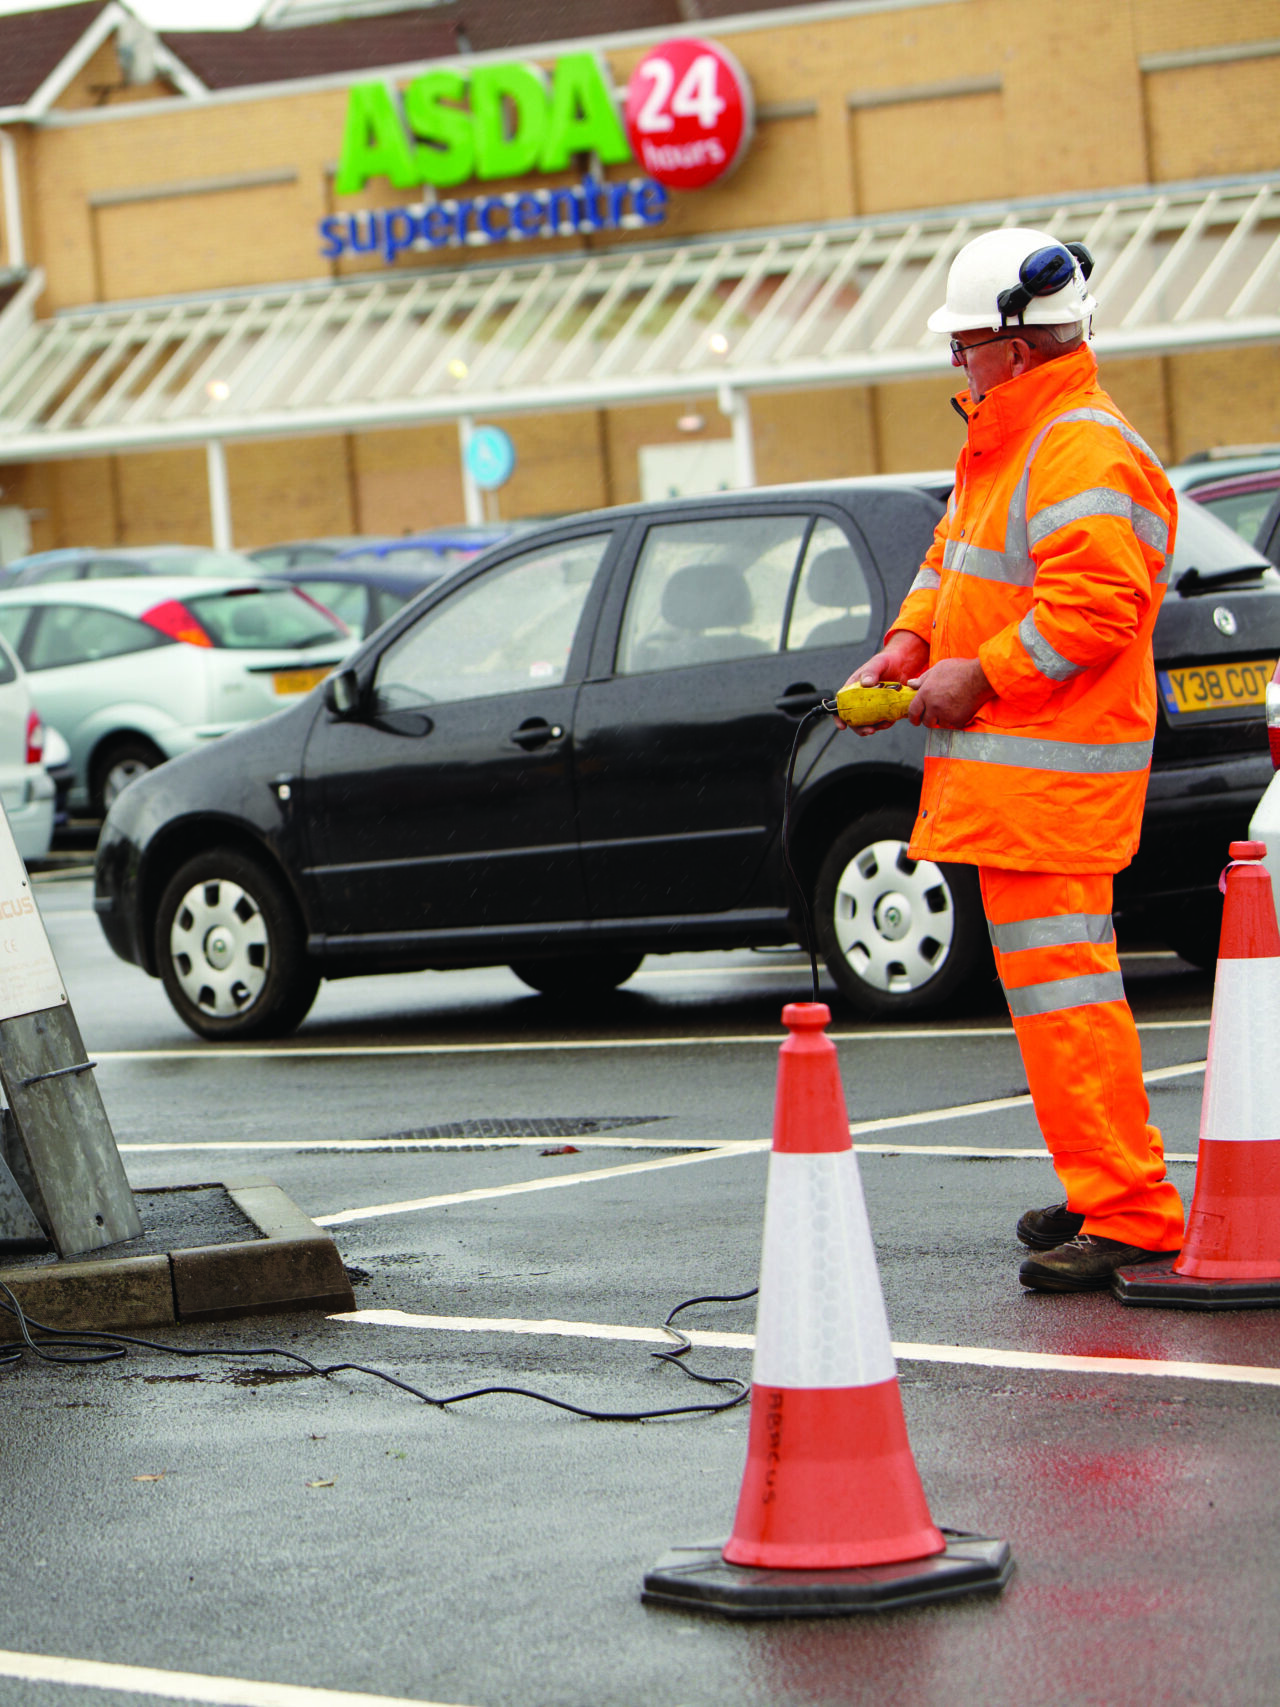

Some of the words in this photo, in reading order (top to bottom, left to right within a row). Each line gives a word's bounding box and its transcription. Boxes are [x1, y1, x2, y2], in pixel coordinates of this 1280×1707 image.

[335, 50, 632, 195] ASDA
[637, 55, 725, 133] 24
[643, 133, 724, 172] hours
[320, 174, 668, 263] supercentre
[1172, 670, 1225, 703] Y38
[1227, 666, 1268, 698] COT
